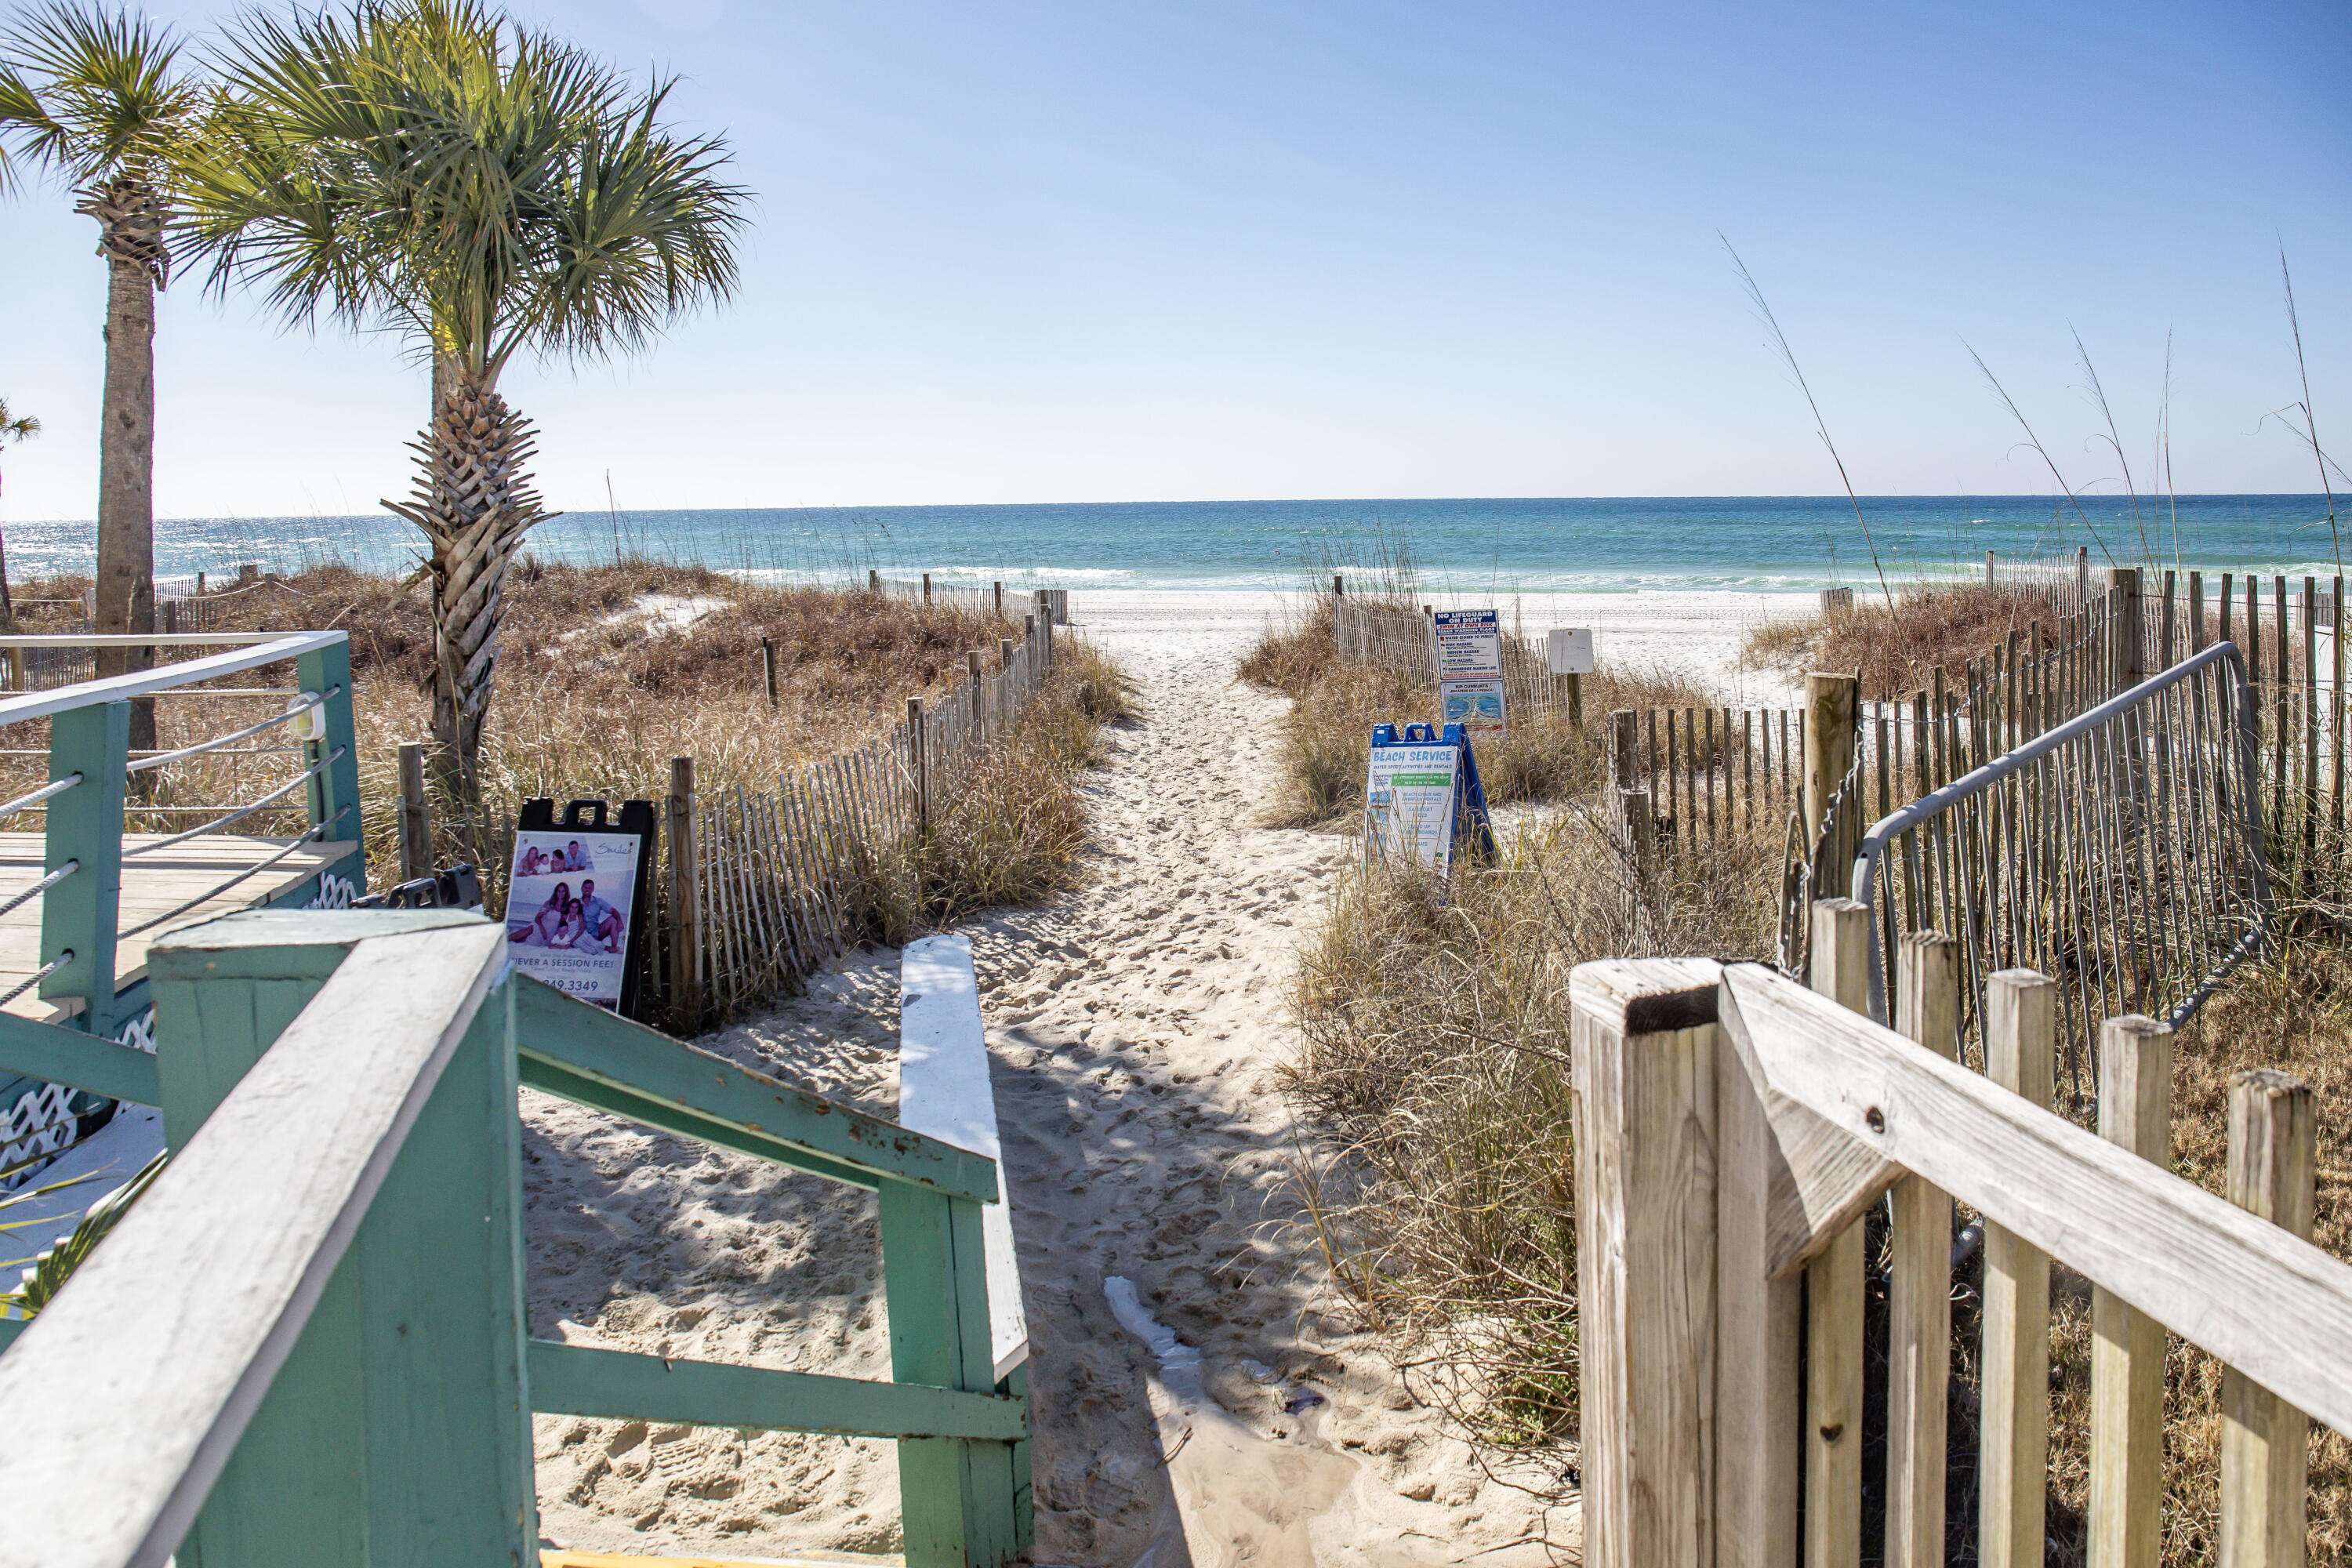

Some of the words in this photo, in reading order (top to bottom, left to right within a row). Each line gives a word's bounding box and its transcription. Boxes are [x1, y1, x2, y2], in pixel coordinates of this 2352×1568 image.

[1374, 751, 1406, 762] BEACH
[1409, 750, 1453, 761] SERVICE
[551, 959, 590, 967] SESSION
[593, 960, 614, 968] FEE!
